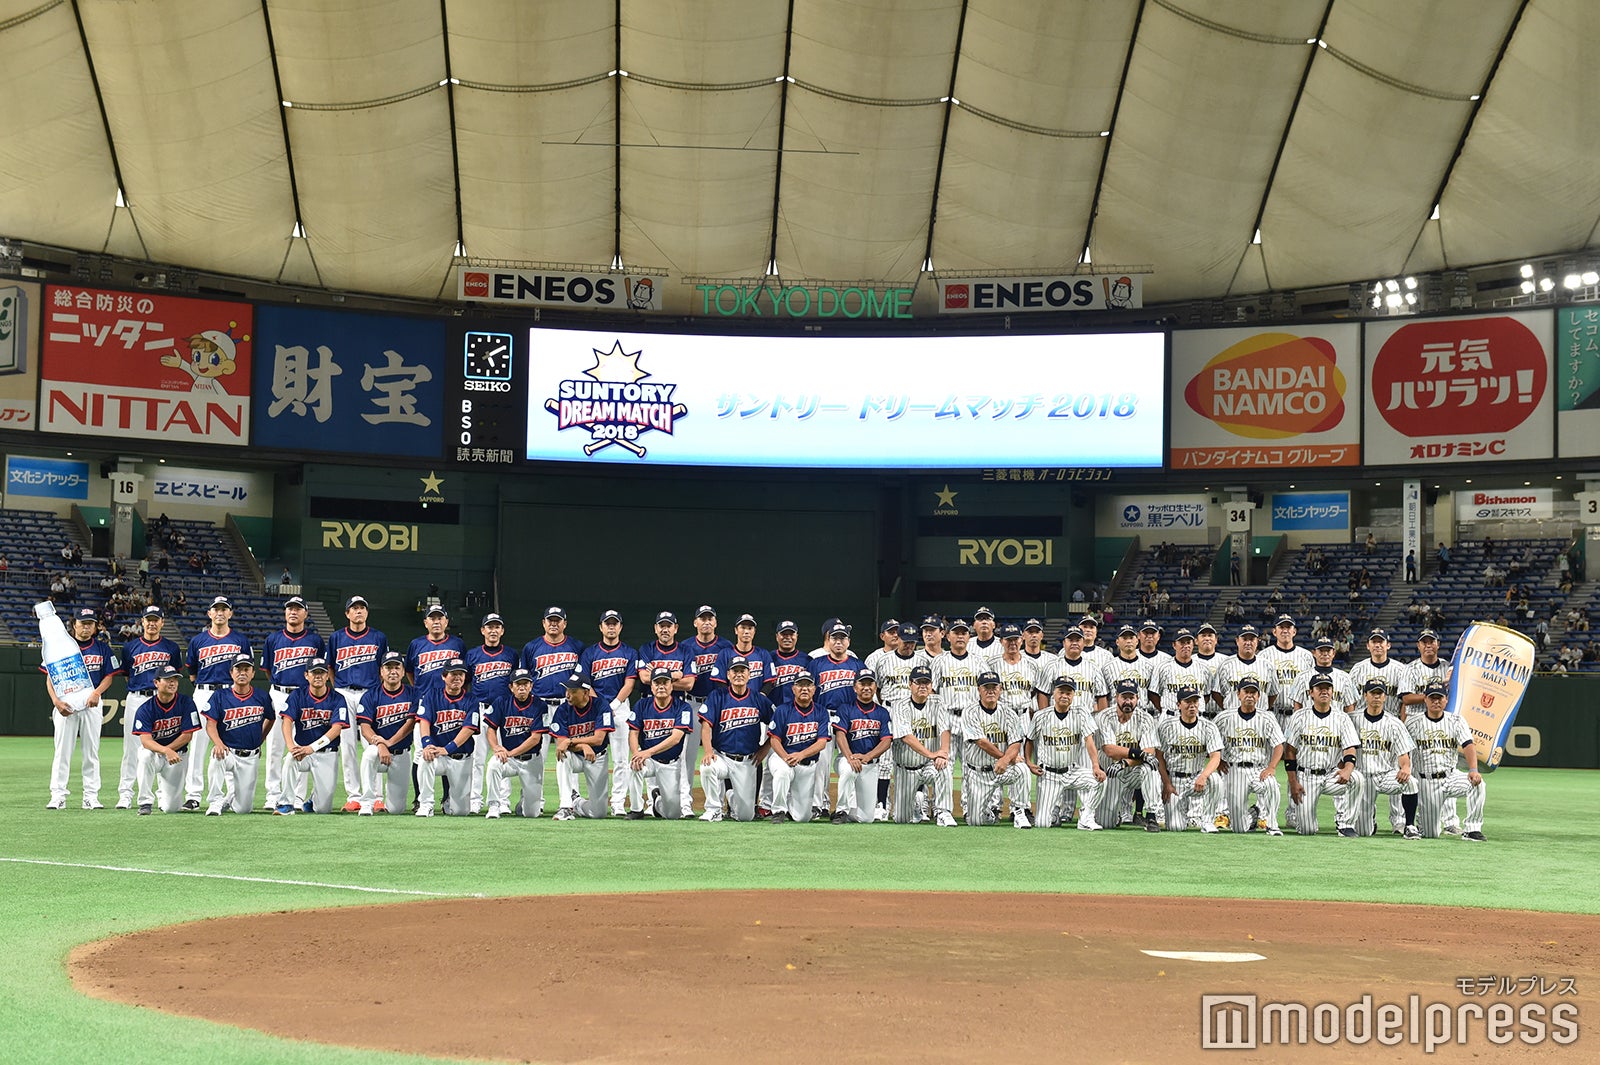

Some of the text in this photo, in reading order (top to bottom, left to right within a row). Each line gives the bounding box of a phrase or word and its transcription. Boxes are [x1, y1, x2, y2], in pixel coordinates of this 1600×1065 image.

[465, 281, 488, 289] ENEOS
[493, 272, 615, 306] ENEOS
[53, 289, 155, 315] 総合防災の
[696, 285, 914, 320] TOKYO DOME
[974, 280, 1093, 308] ENEOS
[49, 312, 175, 351] ニッタン
[1420, 338, 1493, 375] 元気
[268, 344, 433, 428] 財宝
[464, 380, 511, 393] SEIKO
[1213, 366, 1326, 391] BANDAI
[559, 380, 677, 403] SUNTORY
[461, 399, 472, 413] B
[715, 391, 1139, 421] サントリー ドリームマッチ 2018
[1213, 391, 1327, 416] NAMCO
[49, 389, 243, 438] NITTAN
[559, 399, 674, 434] DREAM MATCH
[461, 415, 472, 430] S
[592, 424, 639, 441] 2018
[456, 447, 513, 464] 読売新聞
[1183, 447, 1348, 467] バンダイナムコ グループ
[1410, 440, 1506, 459] オロナミンC
[982, 469, 1035, 481] 三菱電機
[119, 480, 134, 494] 16
[1474, 493, 1537, 506] Bishamon
[1147, 504, 1204, 513] サッポロ生ビール
[1230, 509, 1246, 523] 34
[1147, 513, 1204, 528] 黒ラベル
[321, 521, 419, 552] RYOBI
[958, 538, 1053, 566] RYOBI
[133, 651, 171, 667] DREAM
[199, 645, 241, 659] DREAM
[275, 648, 318, 663] DREAM
[337, 646, 378, 661] DREAM
[419, 650, 460, 665] DREAM
[475, 661, 512, 675] DREAM
[536, 653, 578, 670] DREAM
[592, 658, 628, 673] DREAM
[1462, 646, 1530, 686] PREMIUM
[225, 707, 264, 721] DREAM
[720, 707, 760, 722] DREAM
